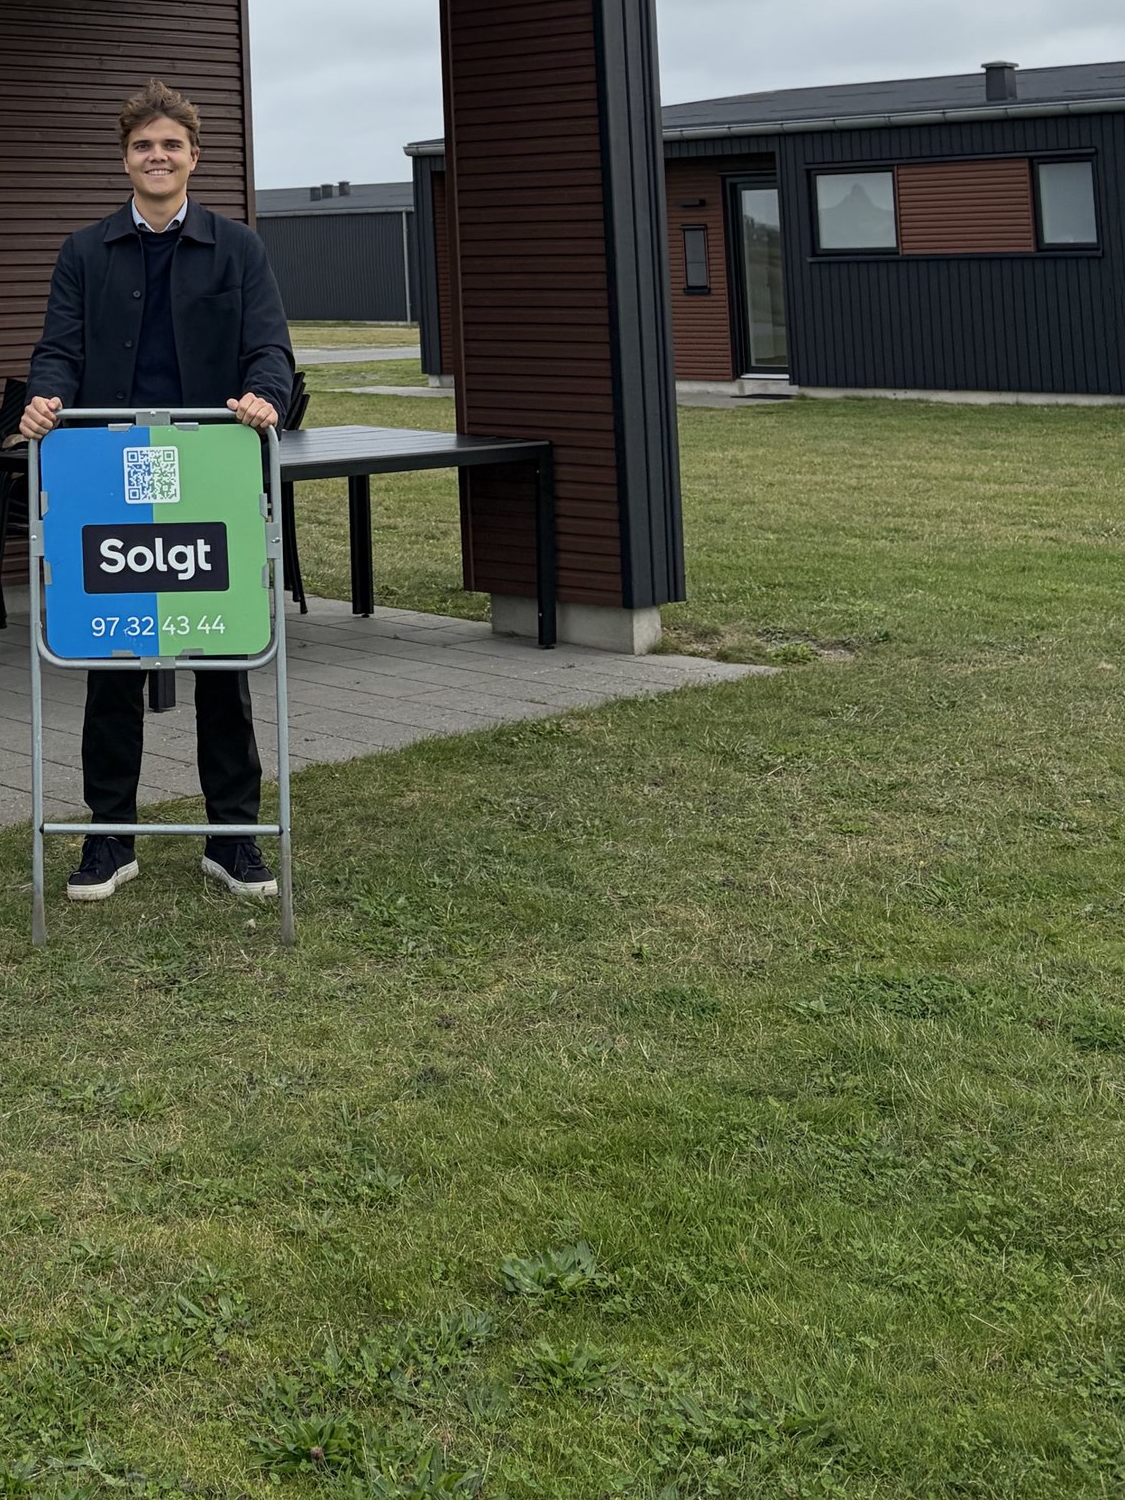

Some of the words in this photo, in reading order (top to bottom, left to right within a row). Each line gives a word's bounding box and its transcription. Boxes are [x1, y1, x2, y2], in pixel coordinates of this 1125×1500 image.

[99, 537, 212, 580] Solgt
[91, 617, 120, 637] 97
[126, 616, 155, 636] 32
[162, 615, 190, 635] 43
[197, 614, 225, 634] 44
